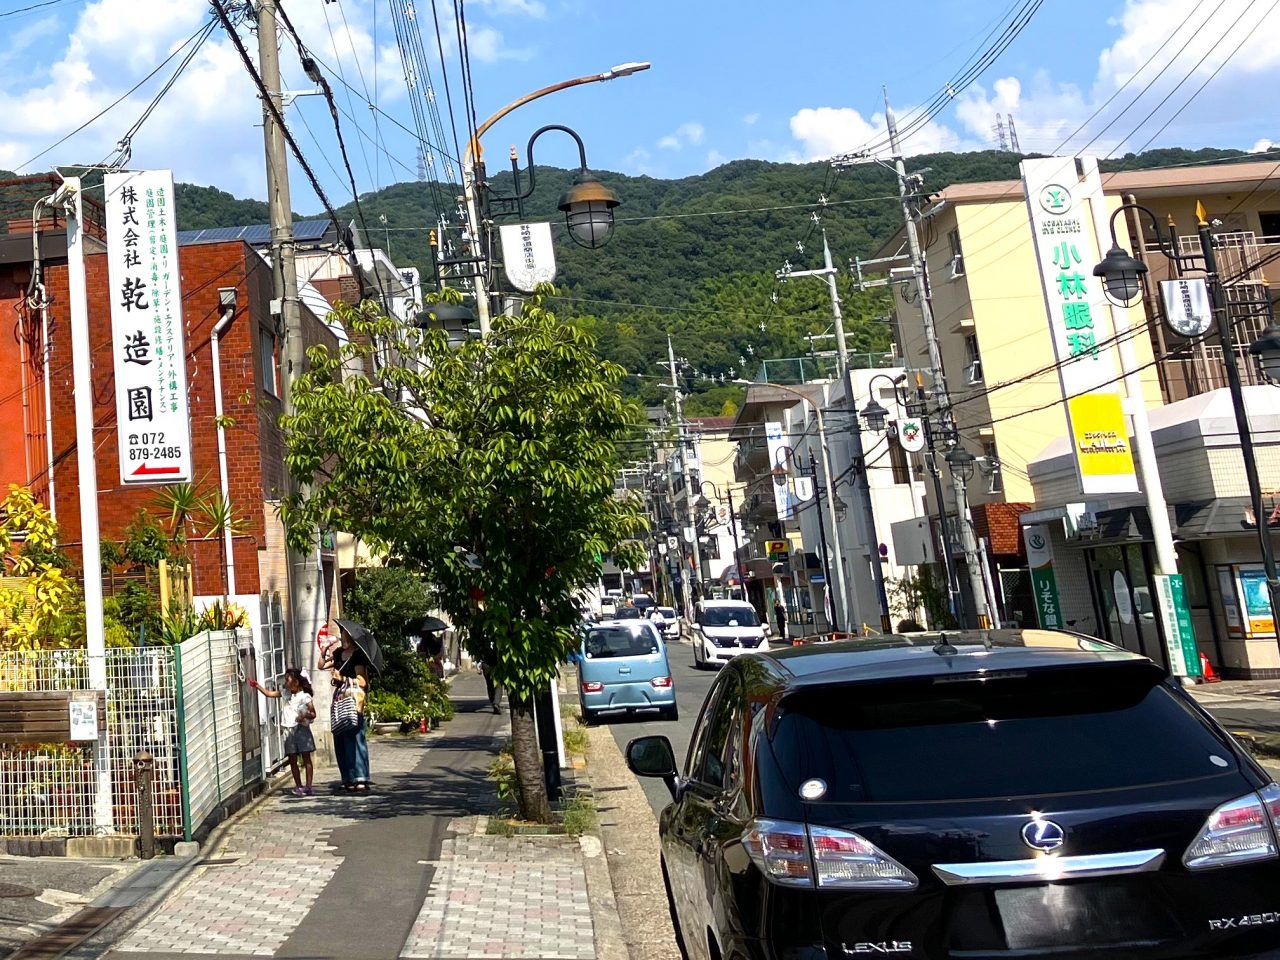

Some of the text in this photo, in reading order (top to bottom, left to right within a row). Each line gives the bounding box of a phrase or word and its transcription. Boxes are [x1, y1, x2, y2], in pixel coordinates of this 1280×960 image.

[120, 185, 154, 422] 株式会社 乾造園
[1052, 240, 1099, 361] 小林眼科
[142, 432, 165, 446] 072
[129, 446, 182, 461] 879-2485
[1039, 579, 1058, 630] りそな銀
[1208, 917, 1237, 931] RX
[841, 940, 912, 954] LEXUS
